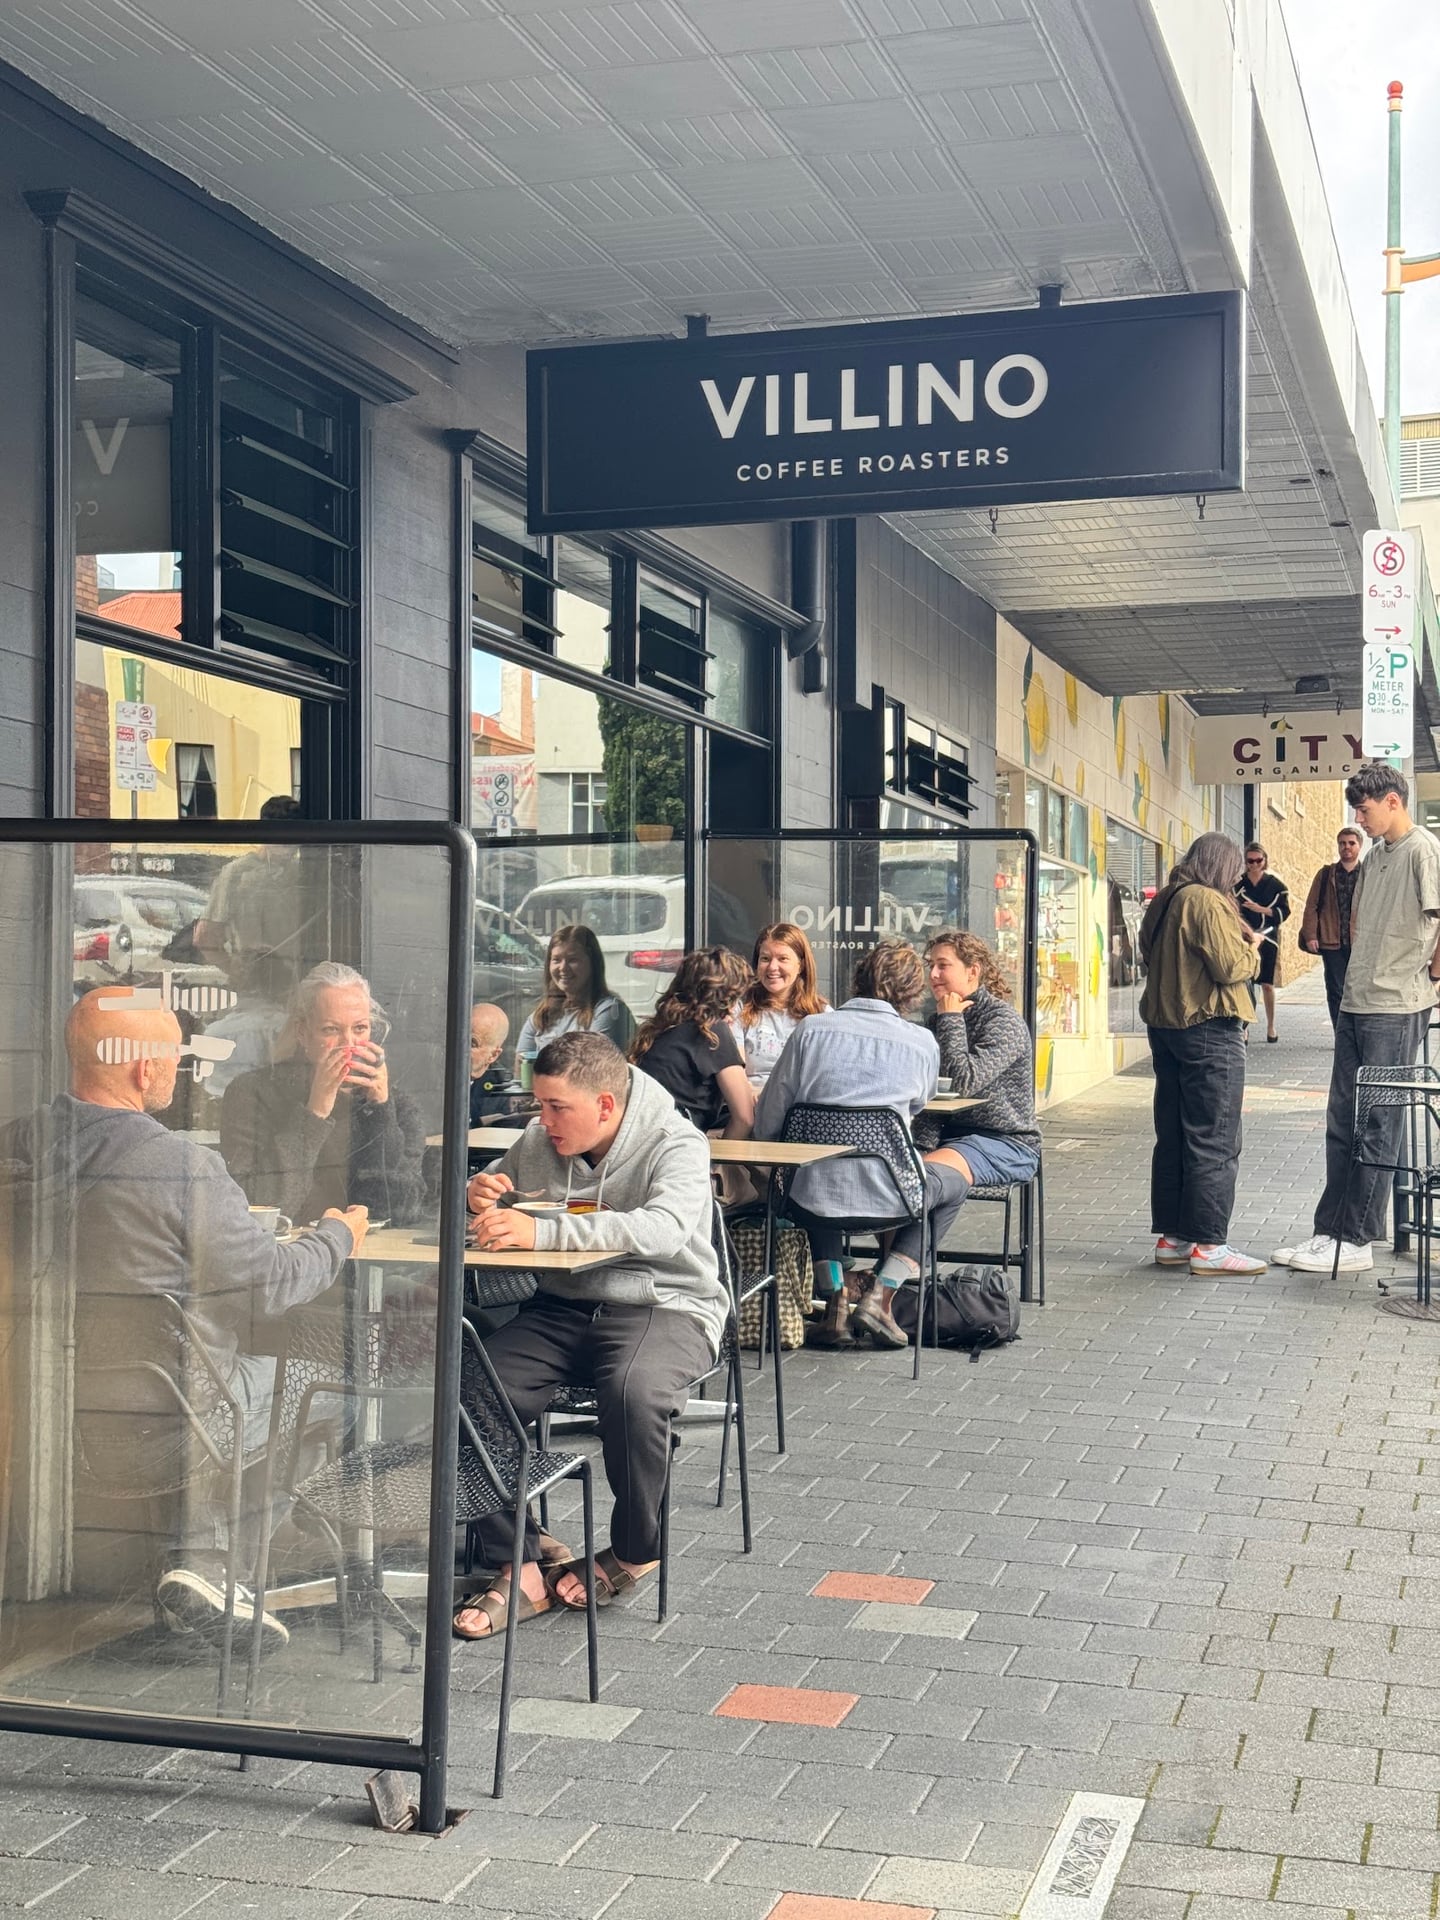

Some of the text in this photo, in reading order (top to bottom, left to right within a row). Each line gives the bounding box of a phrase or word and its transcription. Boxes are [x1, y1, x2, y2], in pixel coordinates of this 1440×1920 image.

[700, 353, 1049, 439] VILLINO
[736, 447, 1010, 482] COFFEE ROASTERS
[1381, 600, 1397, 609] SUN
[1371, 680, 1404, 692] METER
